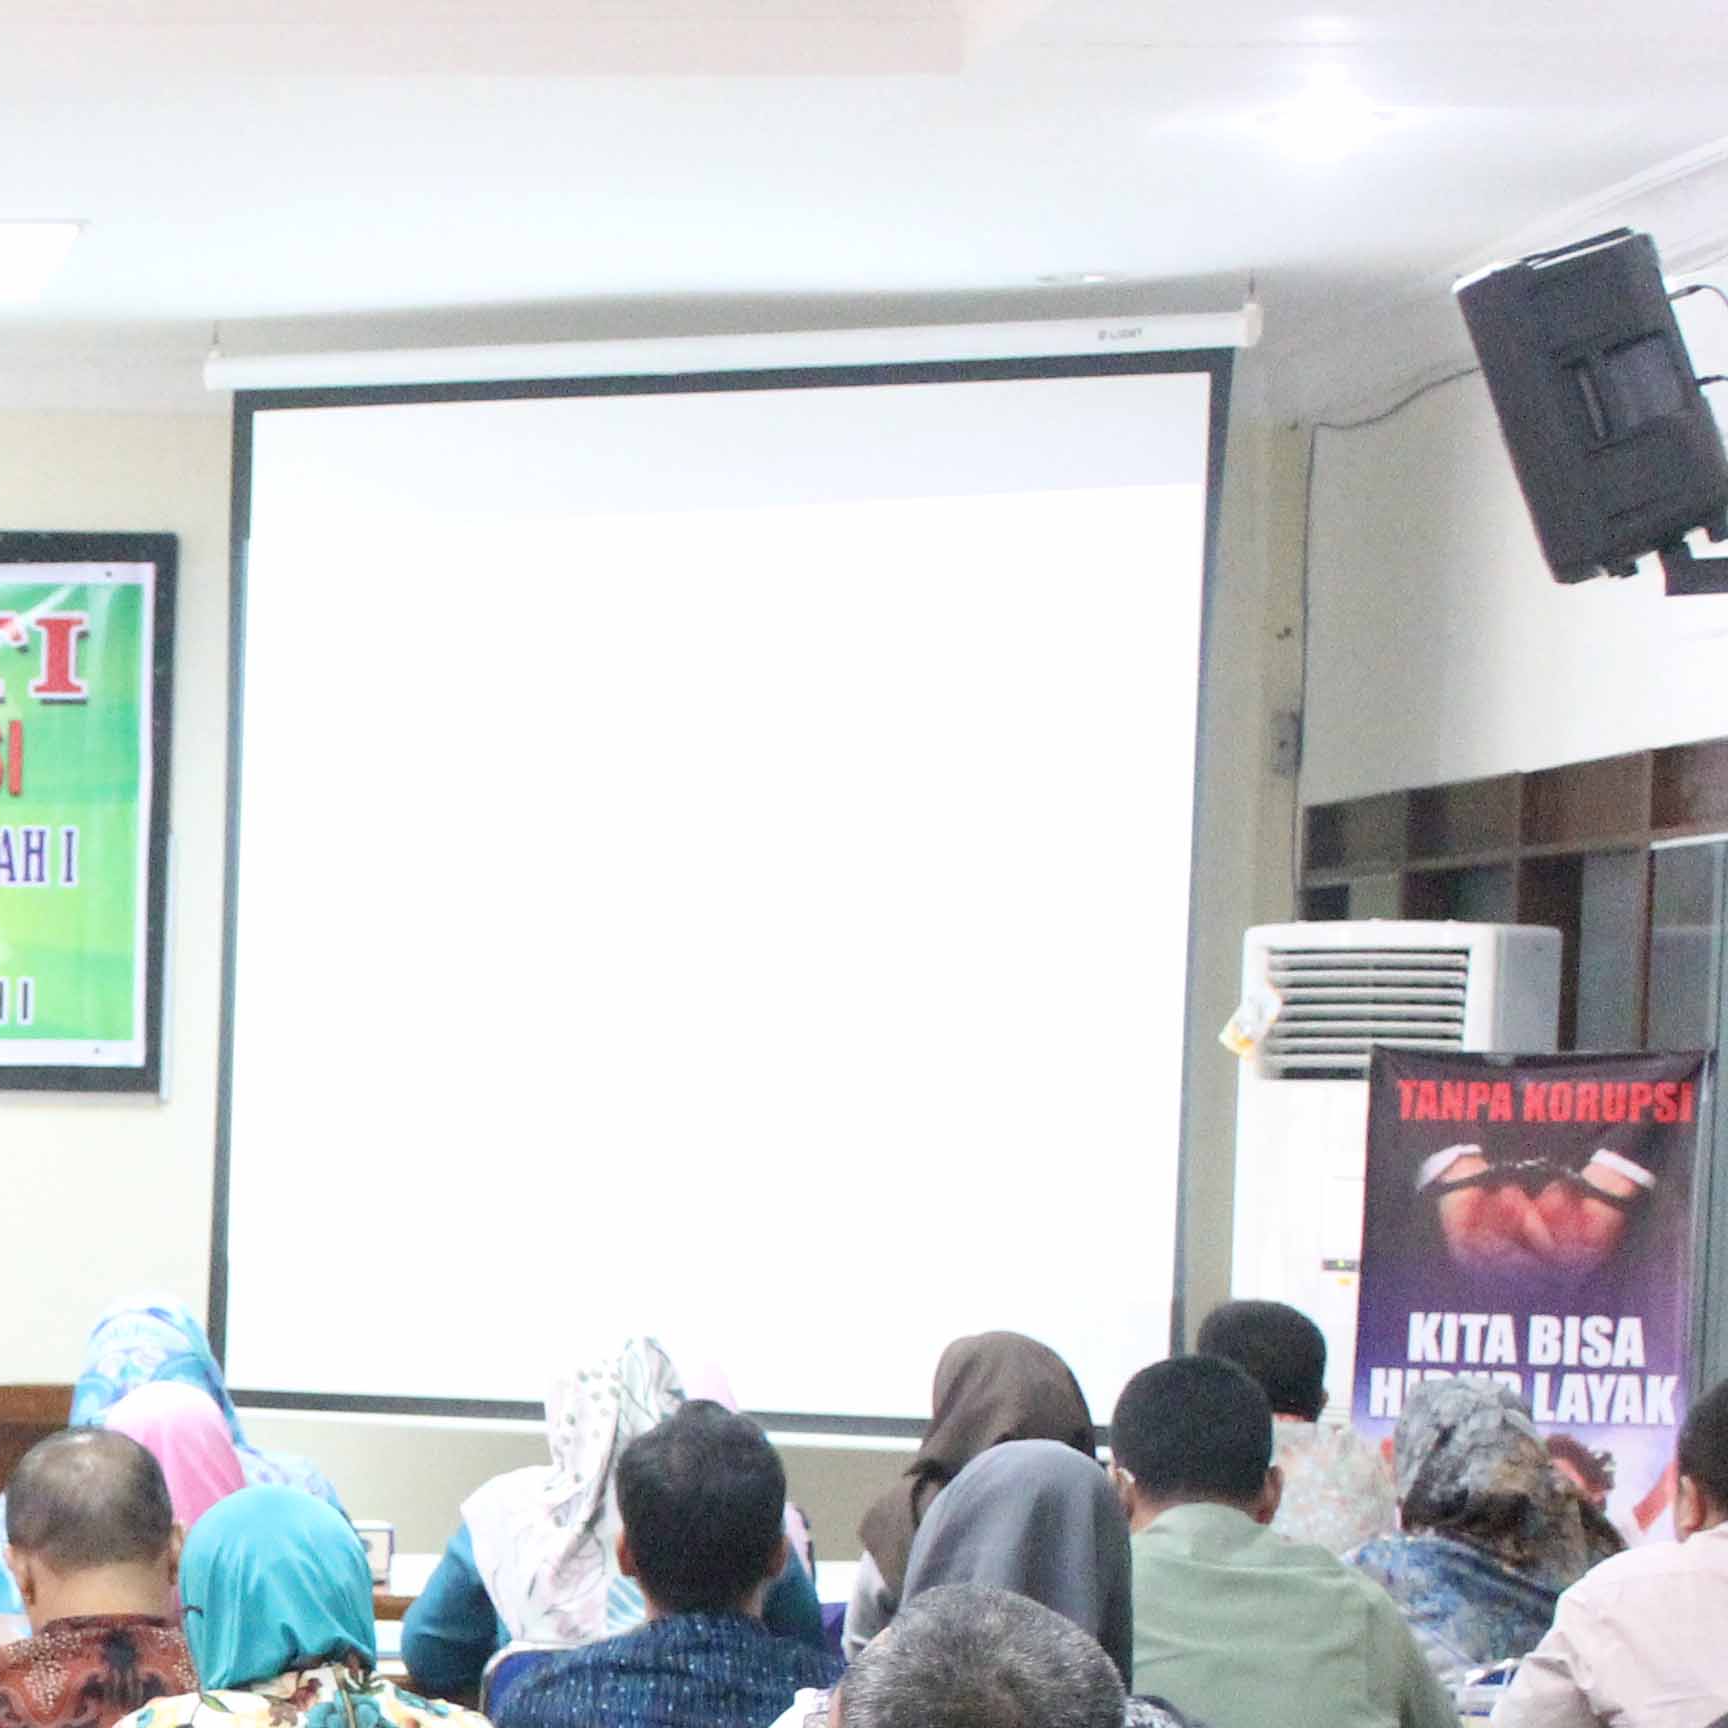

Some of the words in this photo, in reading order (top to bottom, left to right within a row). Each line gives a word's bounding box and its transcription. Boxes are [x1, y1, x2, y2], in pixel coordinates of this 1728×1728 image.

[61, 830, 75, 883] I
[20, 981, 30, 1019] I
[1397, 1078, 1513, 1121] TANPA
[1523, 1081, 1694, 1123] KORUPSI
[1407, 1311, 1518, 1364] KITA
[1527, 1313, 1645, 1367] BISA
[1532, 1371, 1680, 1425] LAYAK
